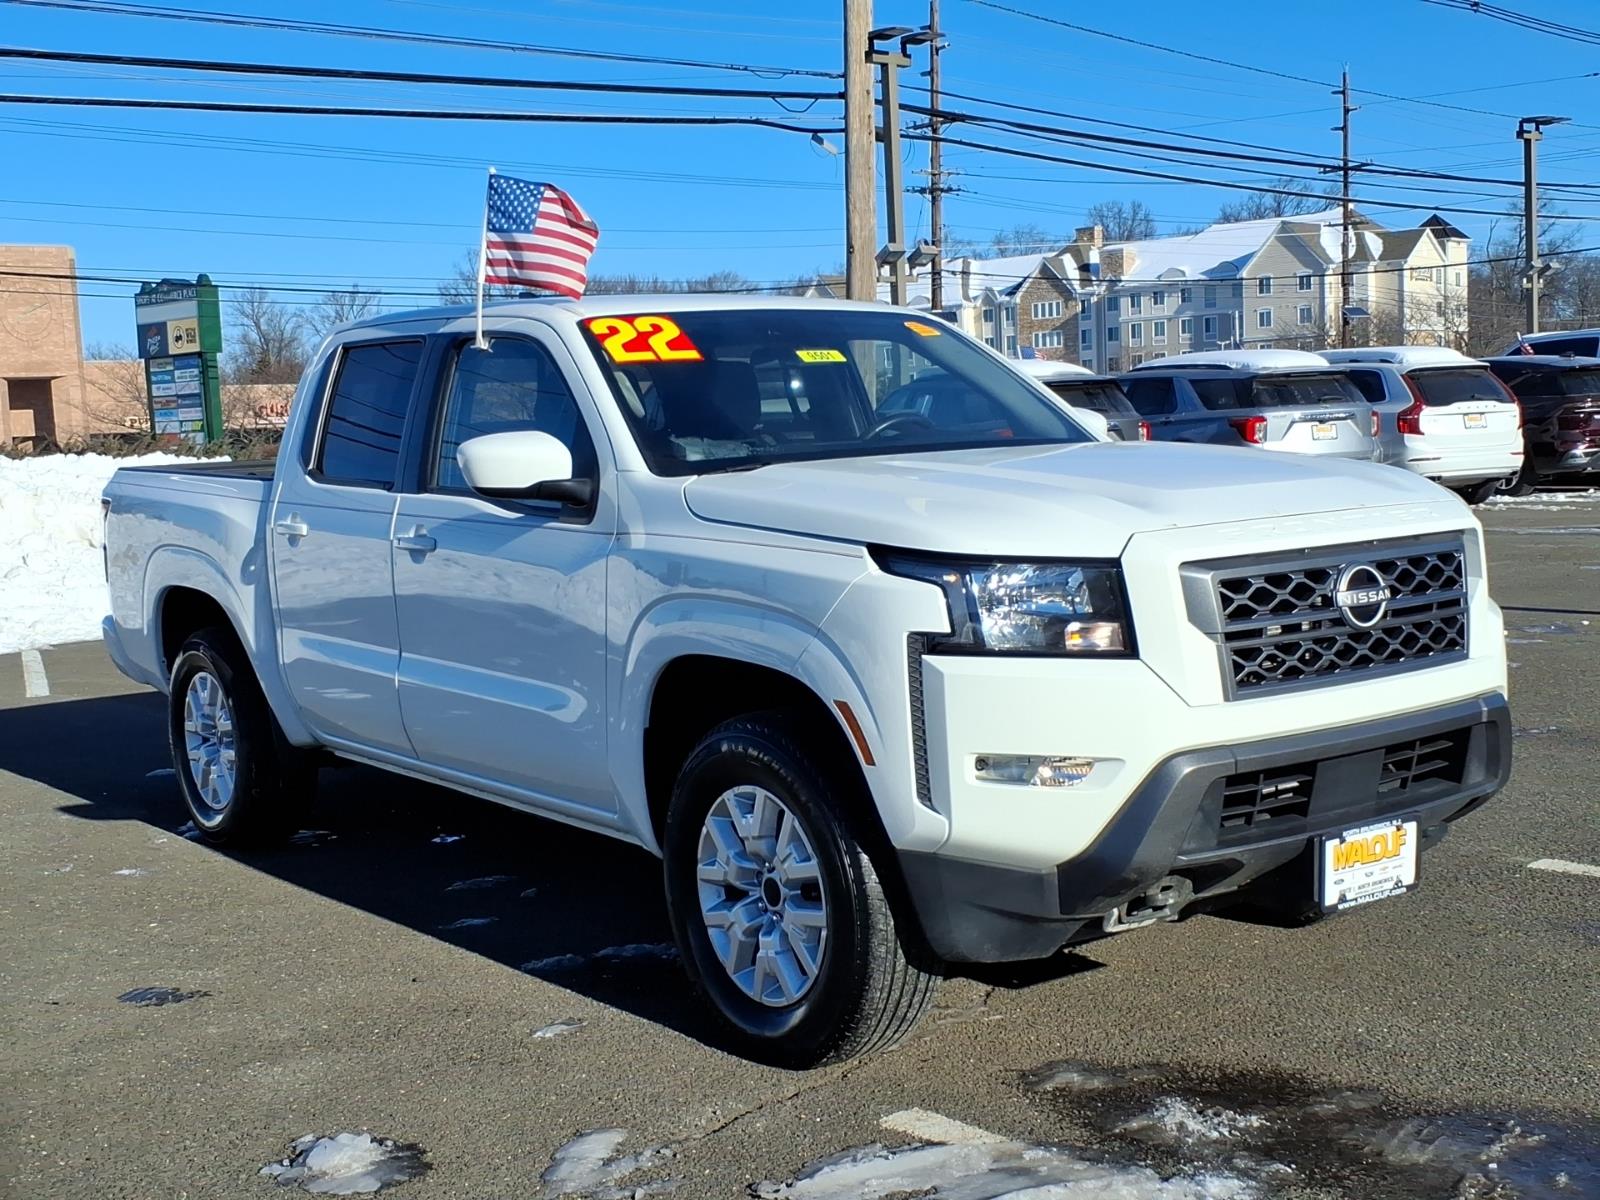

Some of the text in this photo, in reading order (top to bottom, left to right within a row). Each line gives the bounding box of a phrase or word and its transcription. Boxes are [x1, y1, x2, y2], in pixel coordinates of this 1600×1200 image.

[589, 315, 703, 362] 22
[1343, 588, 1391, 604] NISSAN
[1333, 828, 1406, 871] MALOUF
[1337, 887, 1407, 910] www.MALOUF.com
